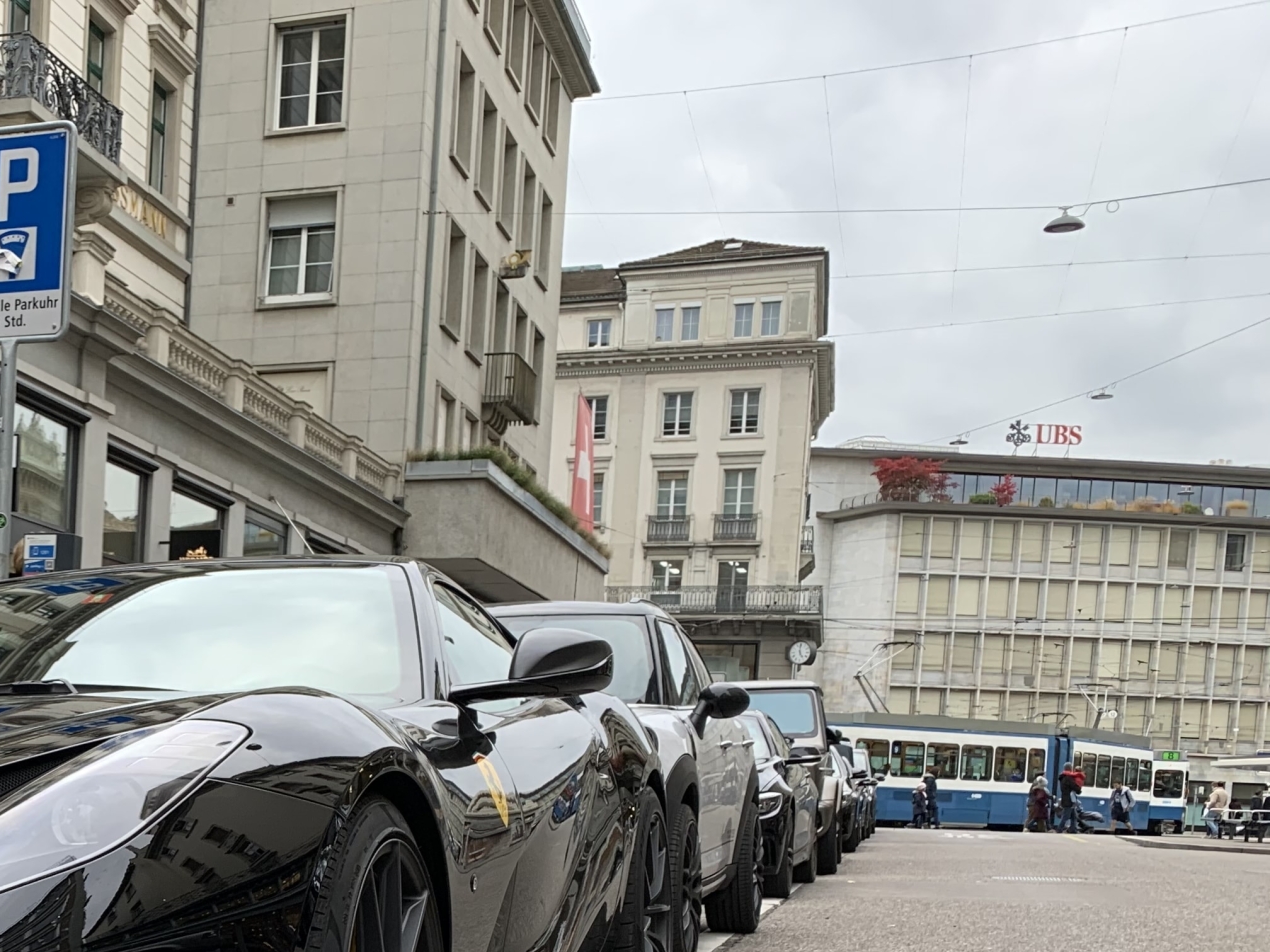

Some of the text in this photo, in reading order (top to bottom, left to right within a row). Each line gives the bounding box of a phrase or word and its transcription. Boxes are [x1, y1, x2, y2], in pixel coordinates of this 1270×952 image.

[14, 296, 59, 311] Parkuhr
[4, 314, 26, 328] Std.
[1036, 423, 1083, 446] UBS
